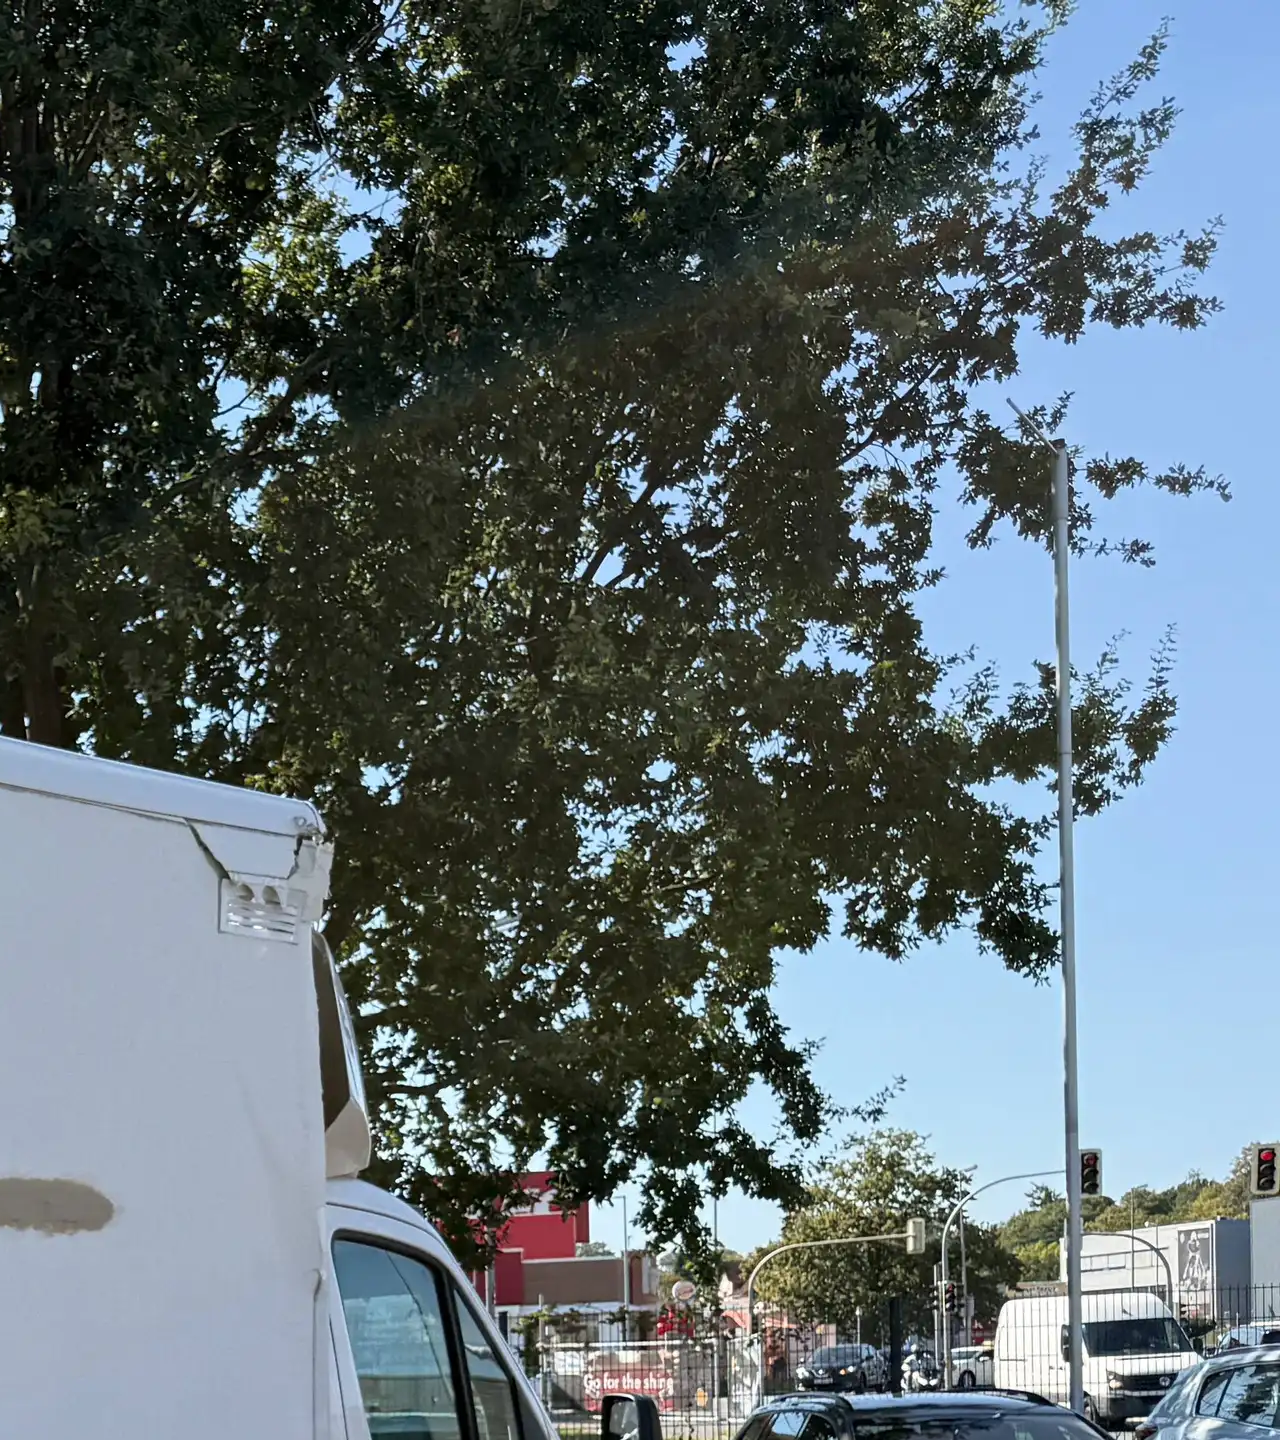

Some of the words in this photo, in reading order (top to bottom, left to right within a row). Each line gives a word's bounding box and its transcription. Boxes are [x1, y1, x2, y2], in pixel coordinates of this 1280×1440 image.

[583, 1373, 601, 1390] Go
[603, 1371, 620, 1390] for
[622, 1371, 641, 1390] the
